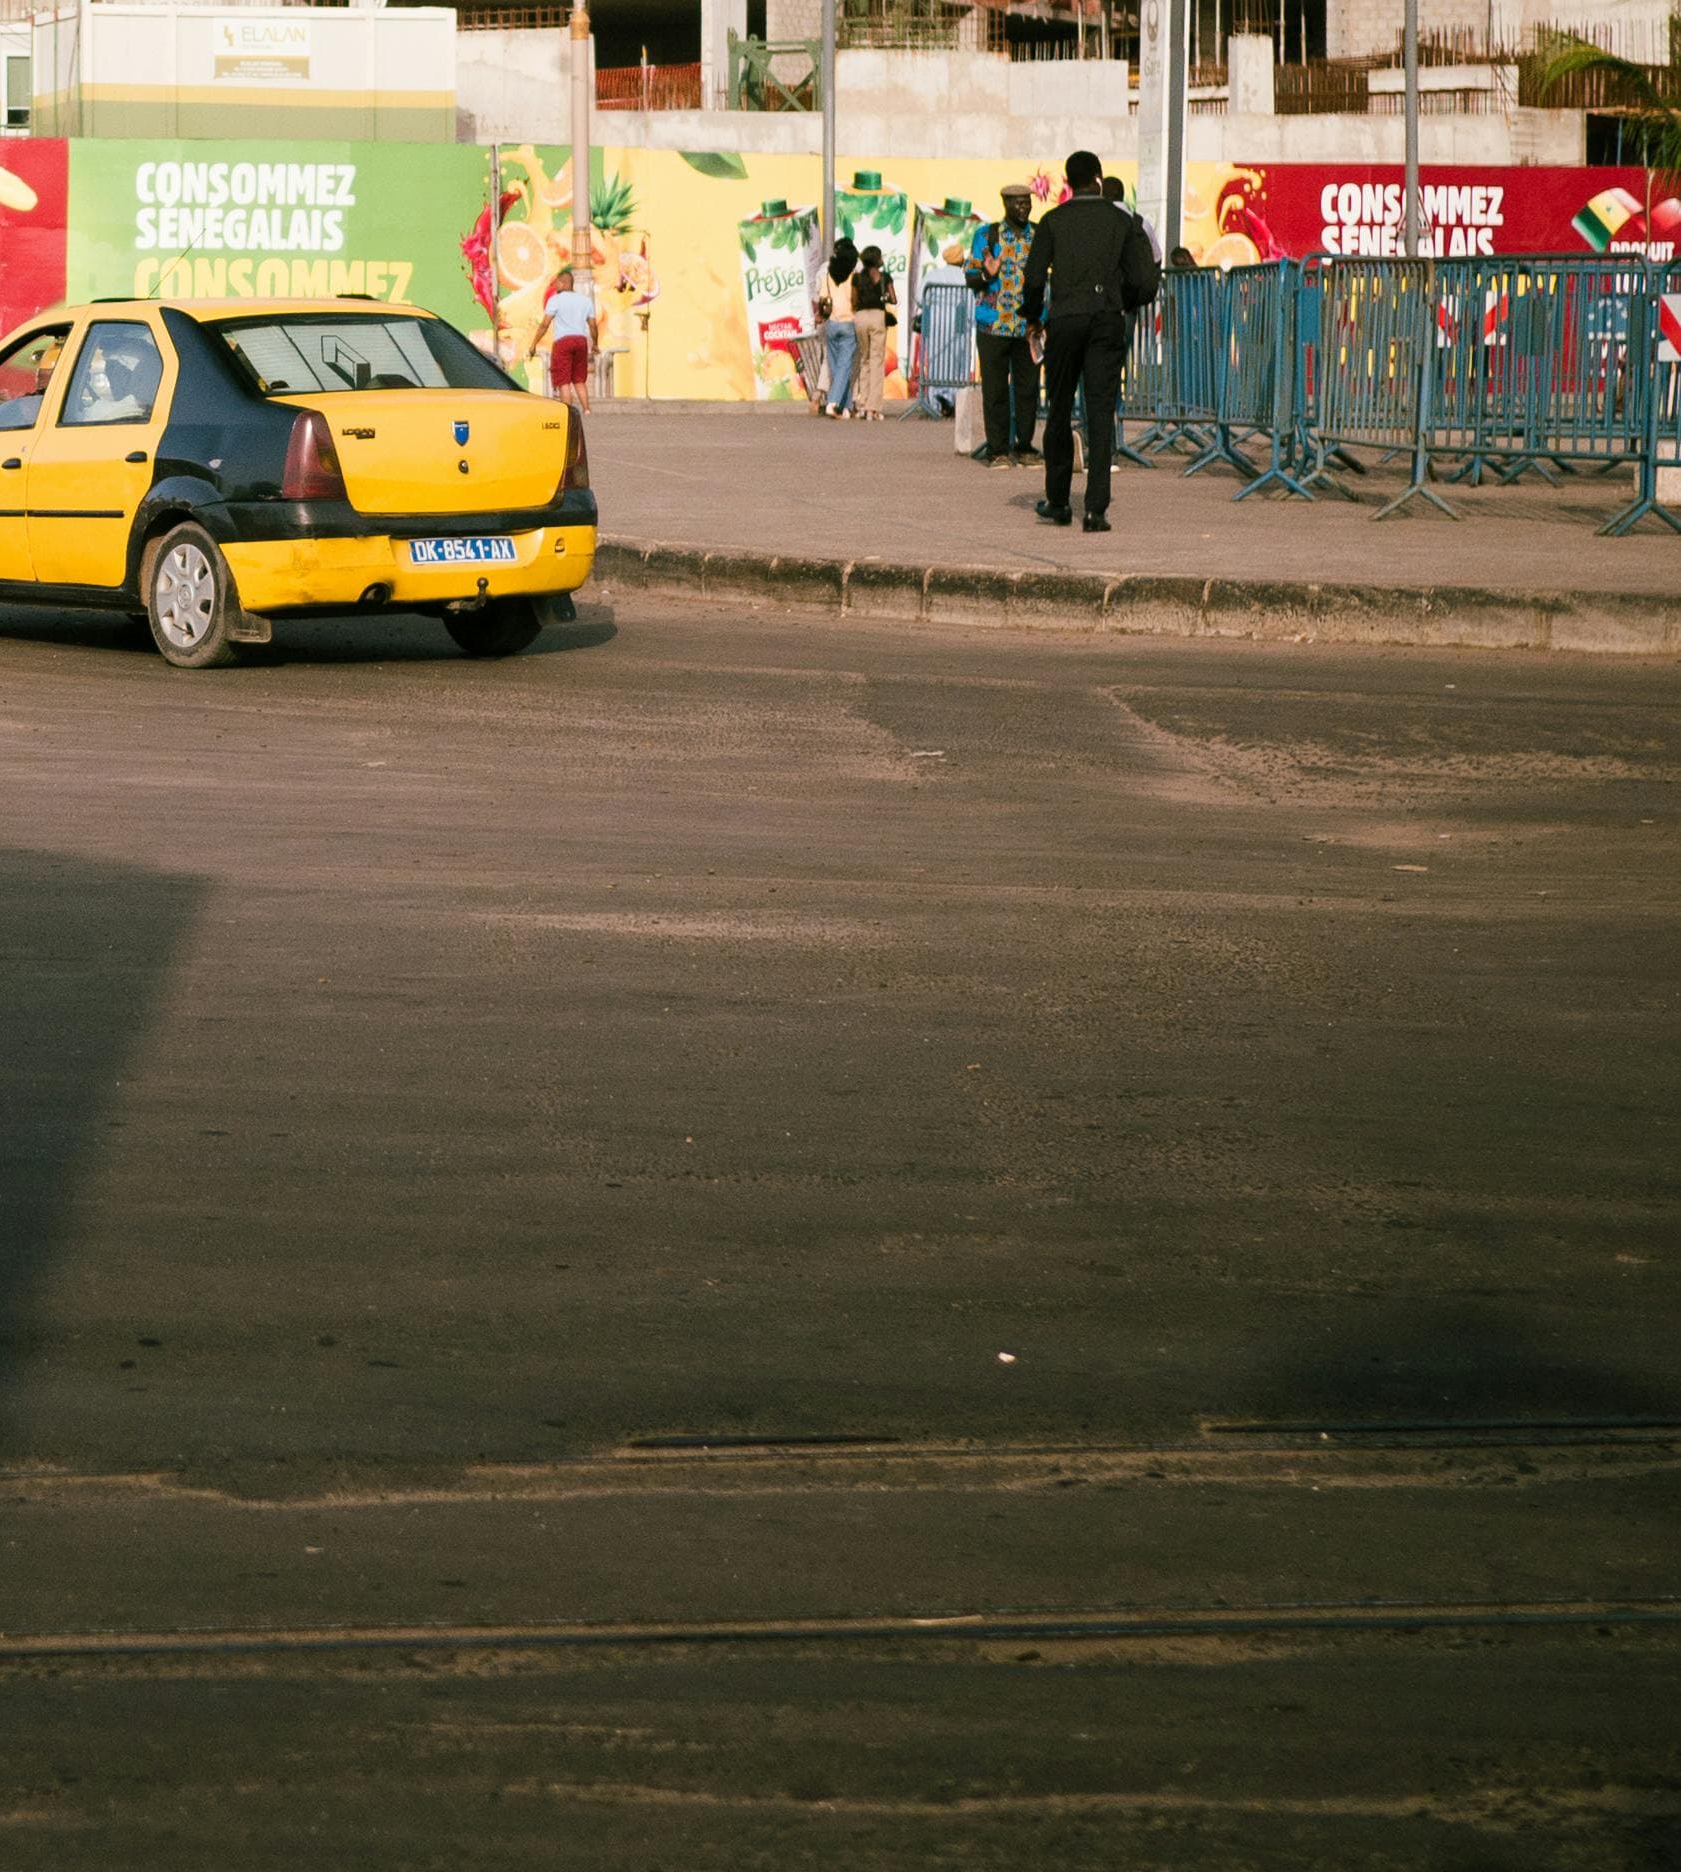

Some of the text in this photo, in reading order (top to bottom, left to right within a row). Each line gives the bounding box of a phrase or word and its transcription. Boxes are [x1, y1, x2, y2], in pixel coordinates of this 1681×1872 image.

[135, 162, 356, 206] CONSOMMEZ
[134, 257, 413, 305] CONSOMMEZ
[414, 539, 512, 560] DK-8541-AX
